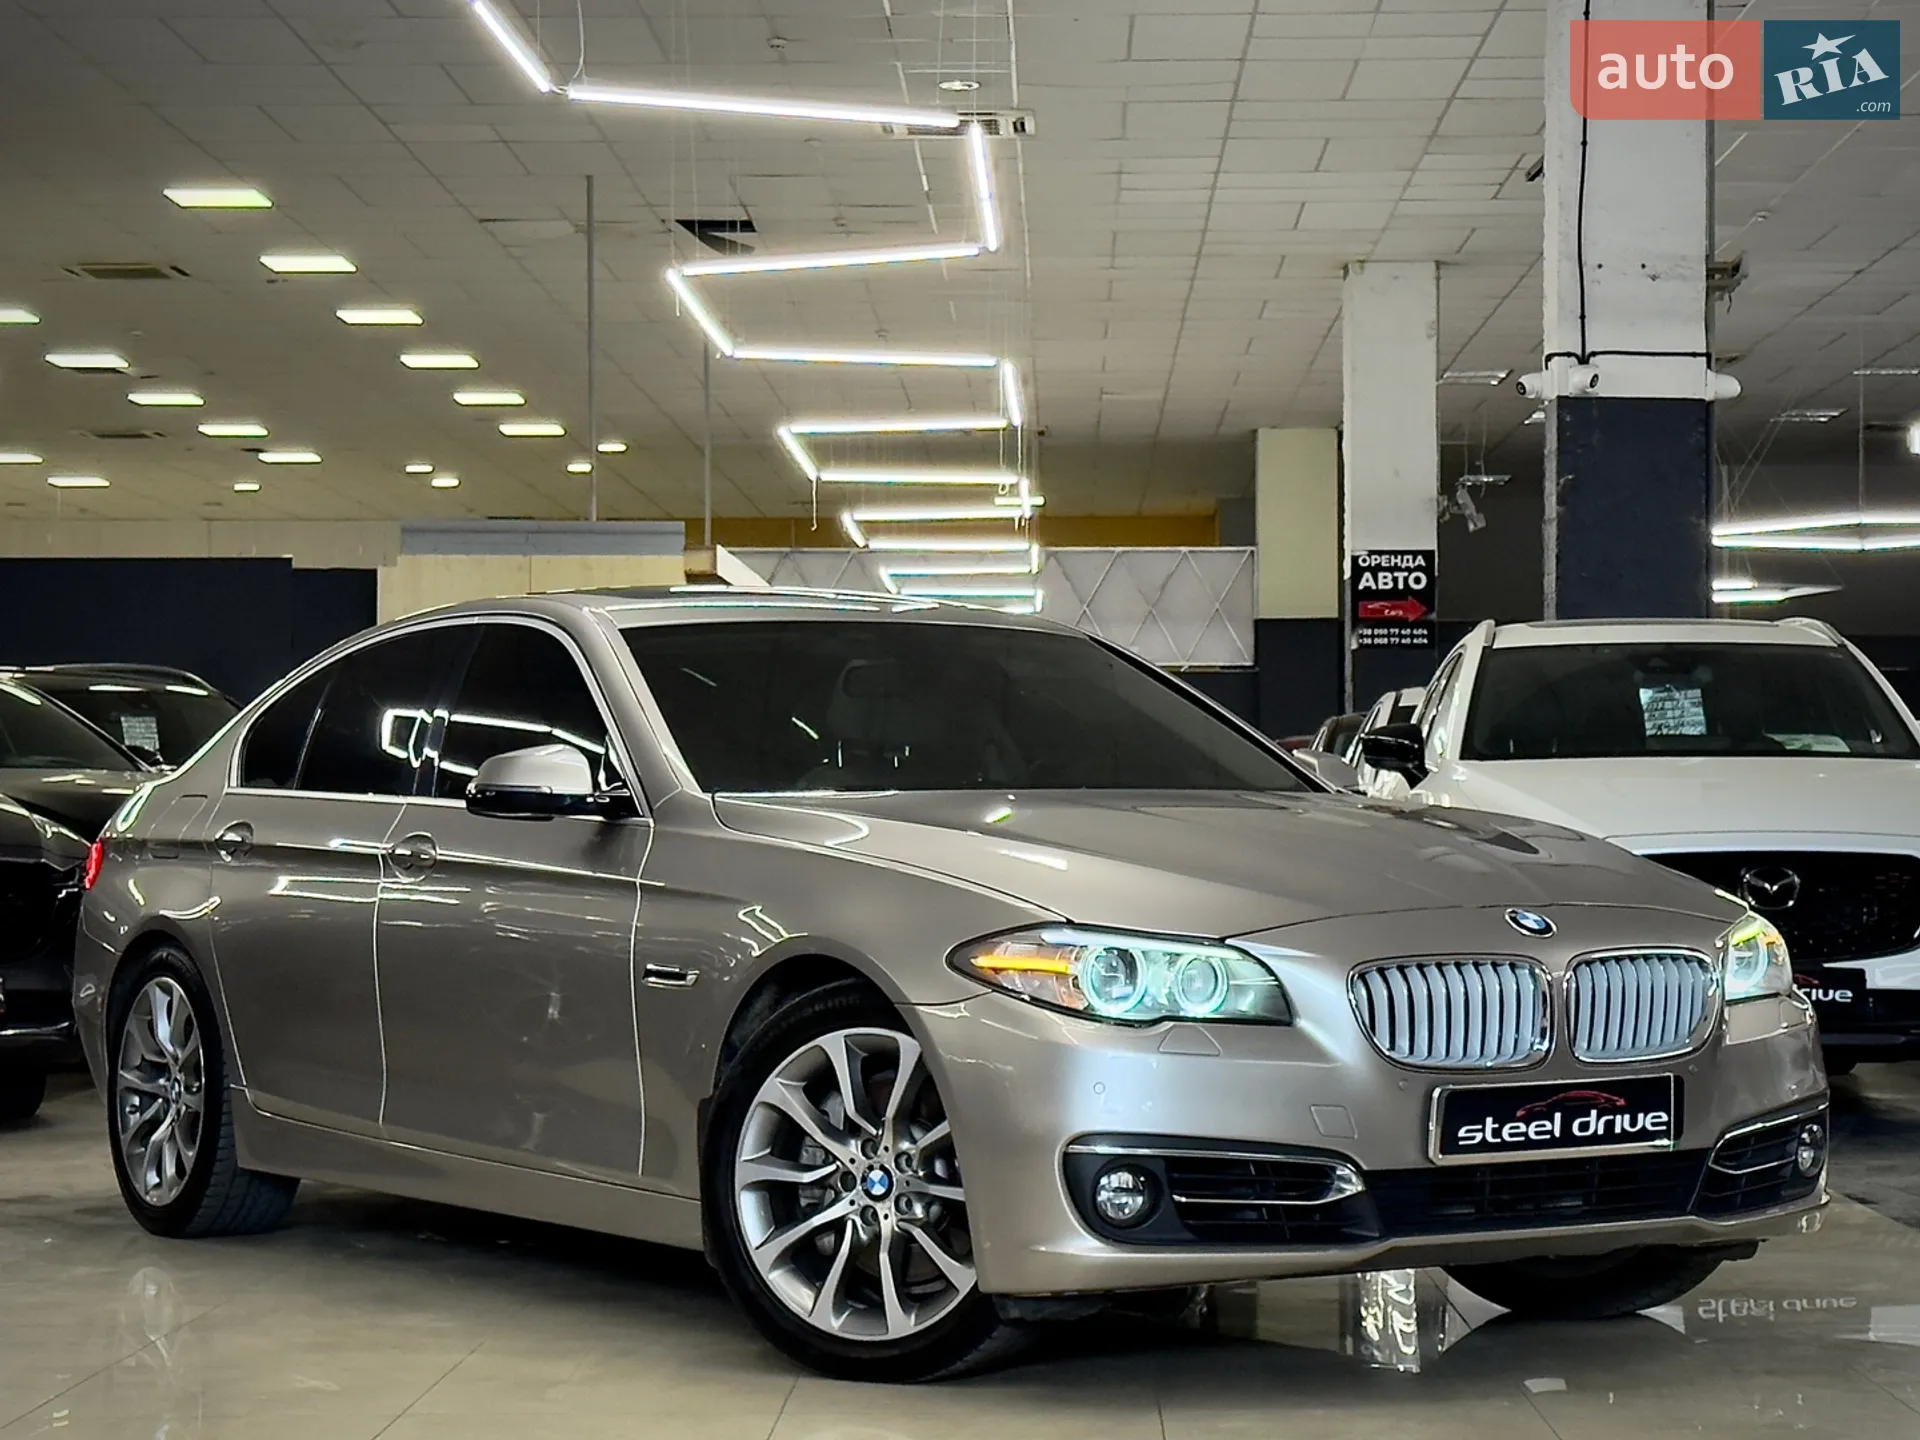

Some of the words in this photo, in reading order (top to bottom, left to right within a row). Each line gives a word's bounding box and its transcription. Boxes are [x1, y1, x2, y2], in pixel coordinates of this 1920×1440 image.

[1358, 554, 1426, 569] ОРЕНДА
[1358, 571, 1428, 590] АВТО
[1800, 988, 1853, 1003] rive
[1457, 1111, 1562, 1145] steel
[1571, 1109, 1669, 1137] drive
